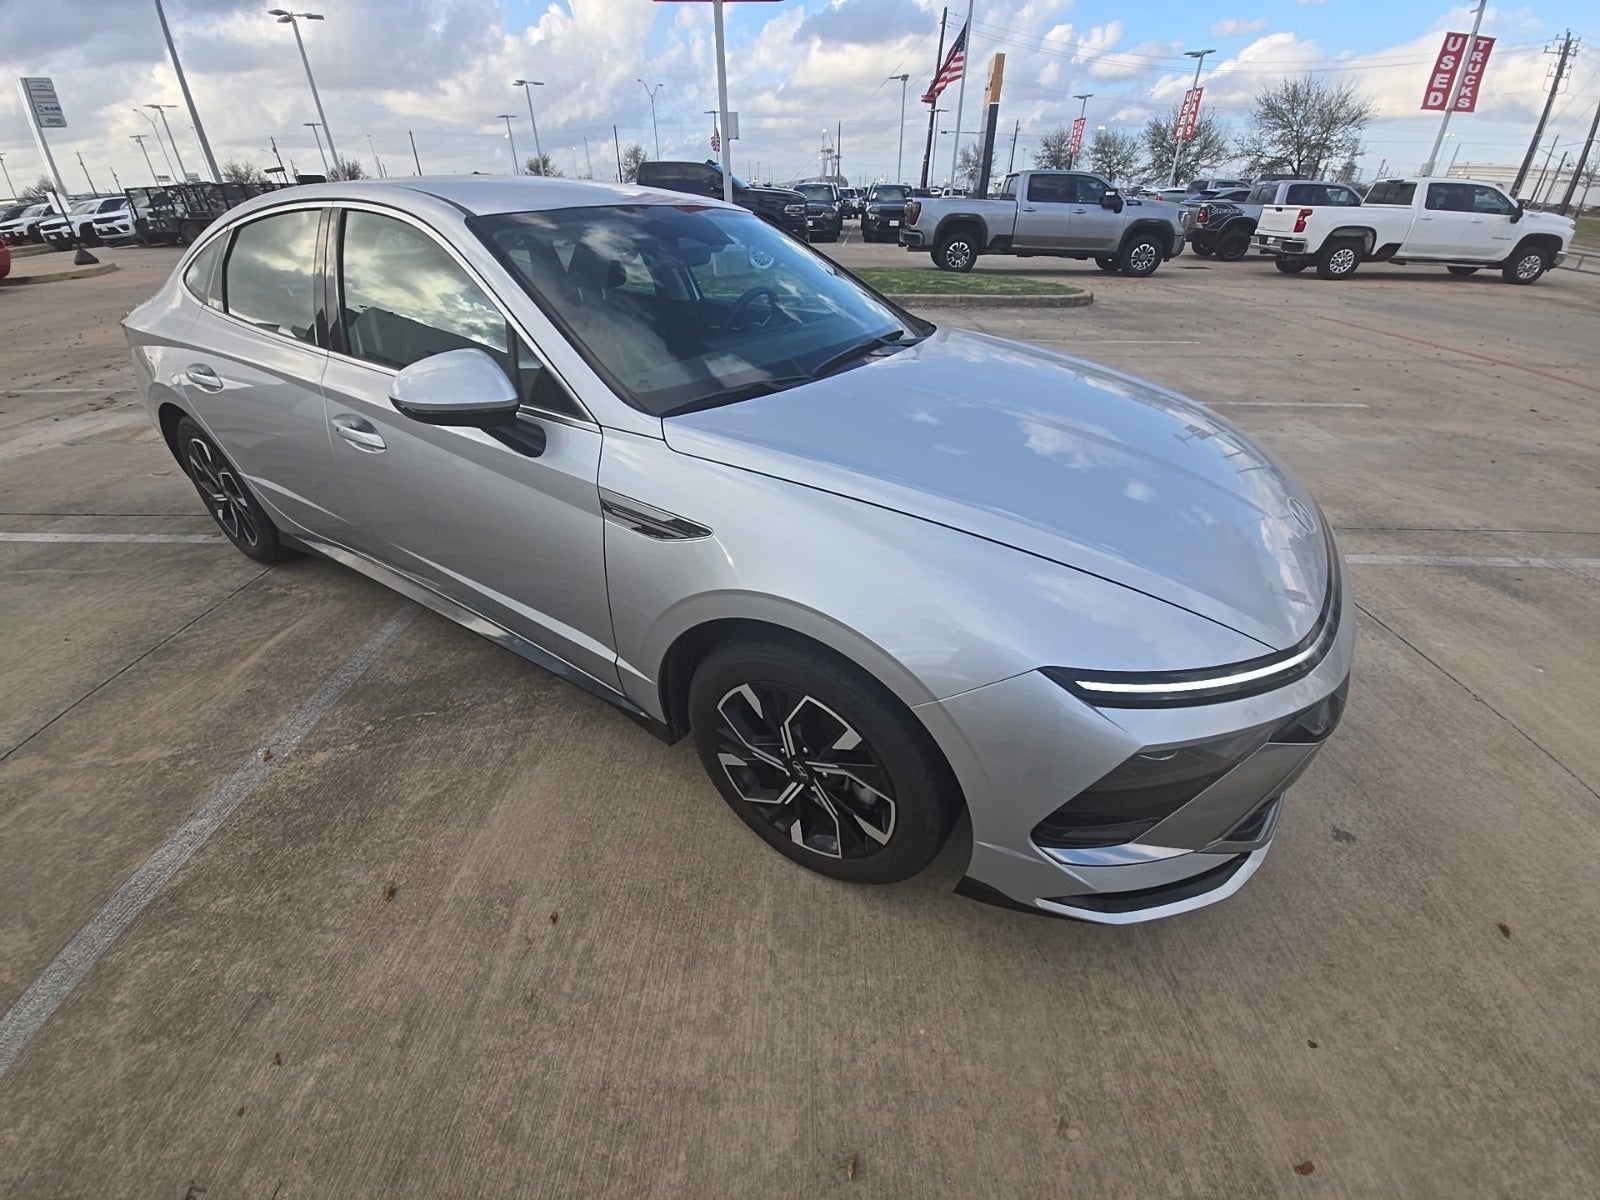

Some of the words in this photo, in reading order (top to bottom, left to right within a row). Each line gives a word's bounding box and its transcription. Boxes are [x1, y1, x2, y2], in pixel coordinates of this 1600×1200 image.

[1427, 36, 1464, 106] USED
[1457, 40, 1490, 107] TRUCKS
[1176, 92, 1191, 137] USED
